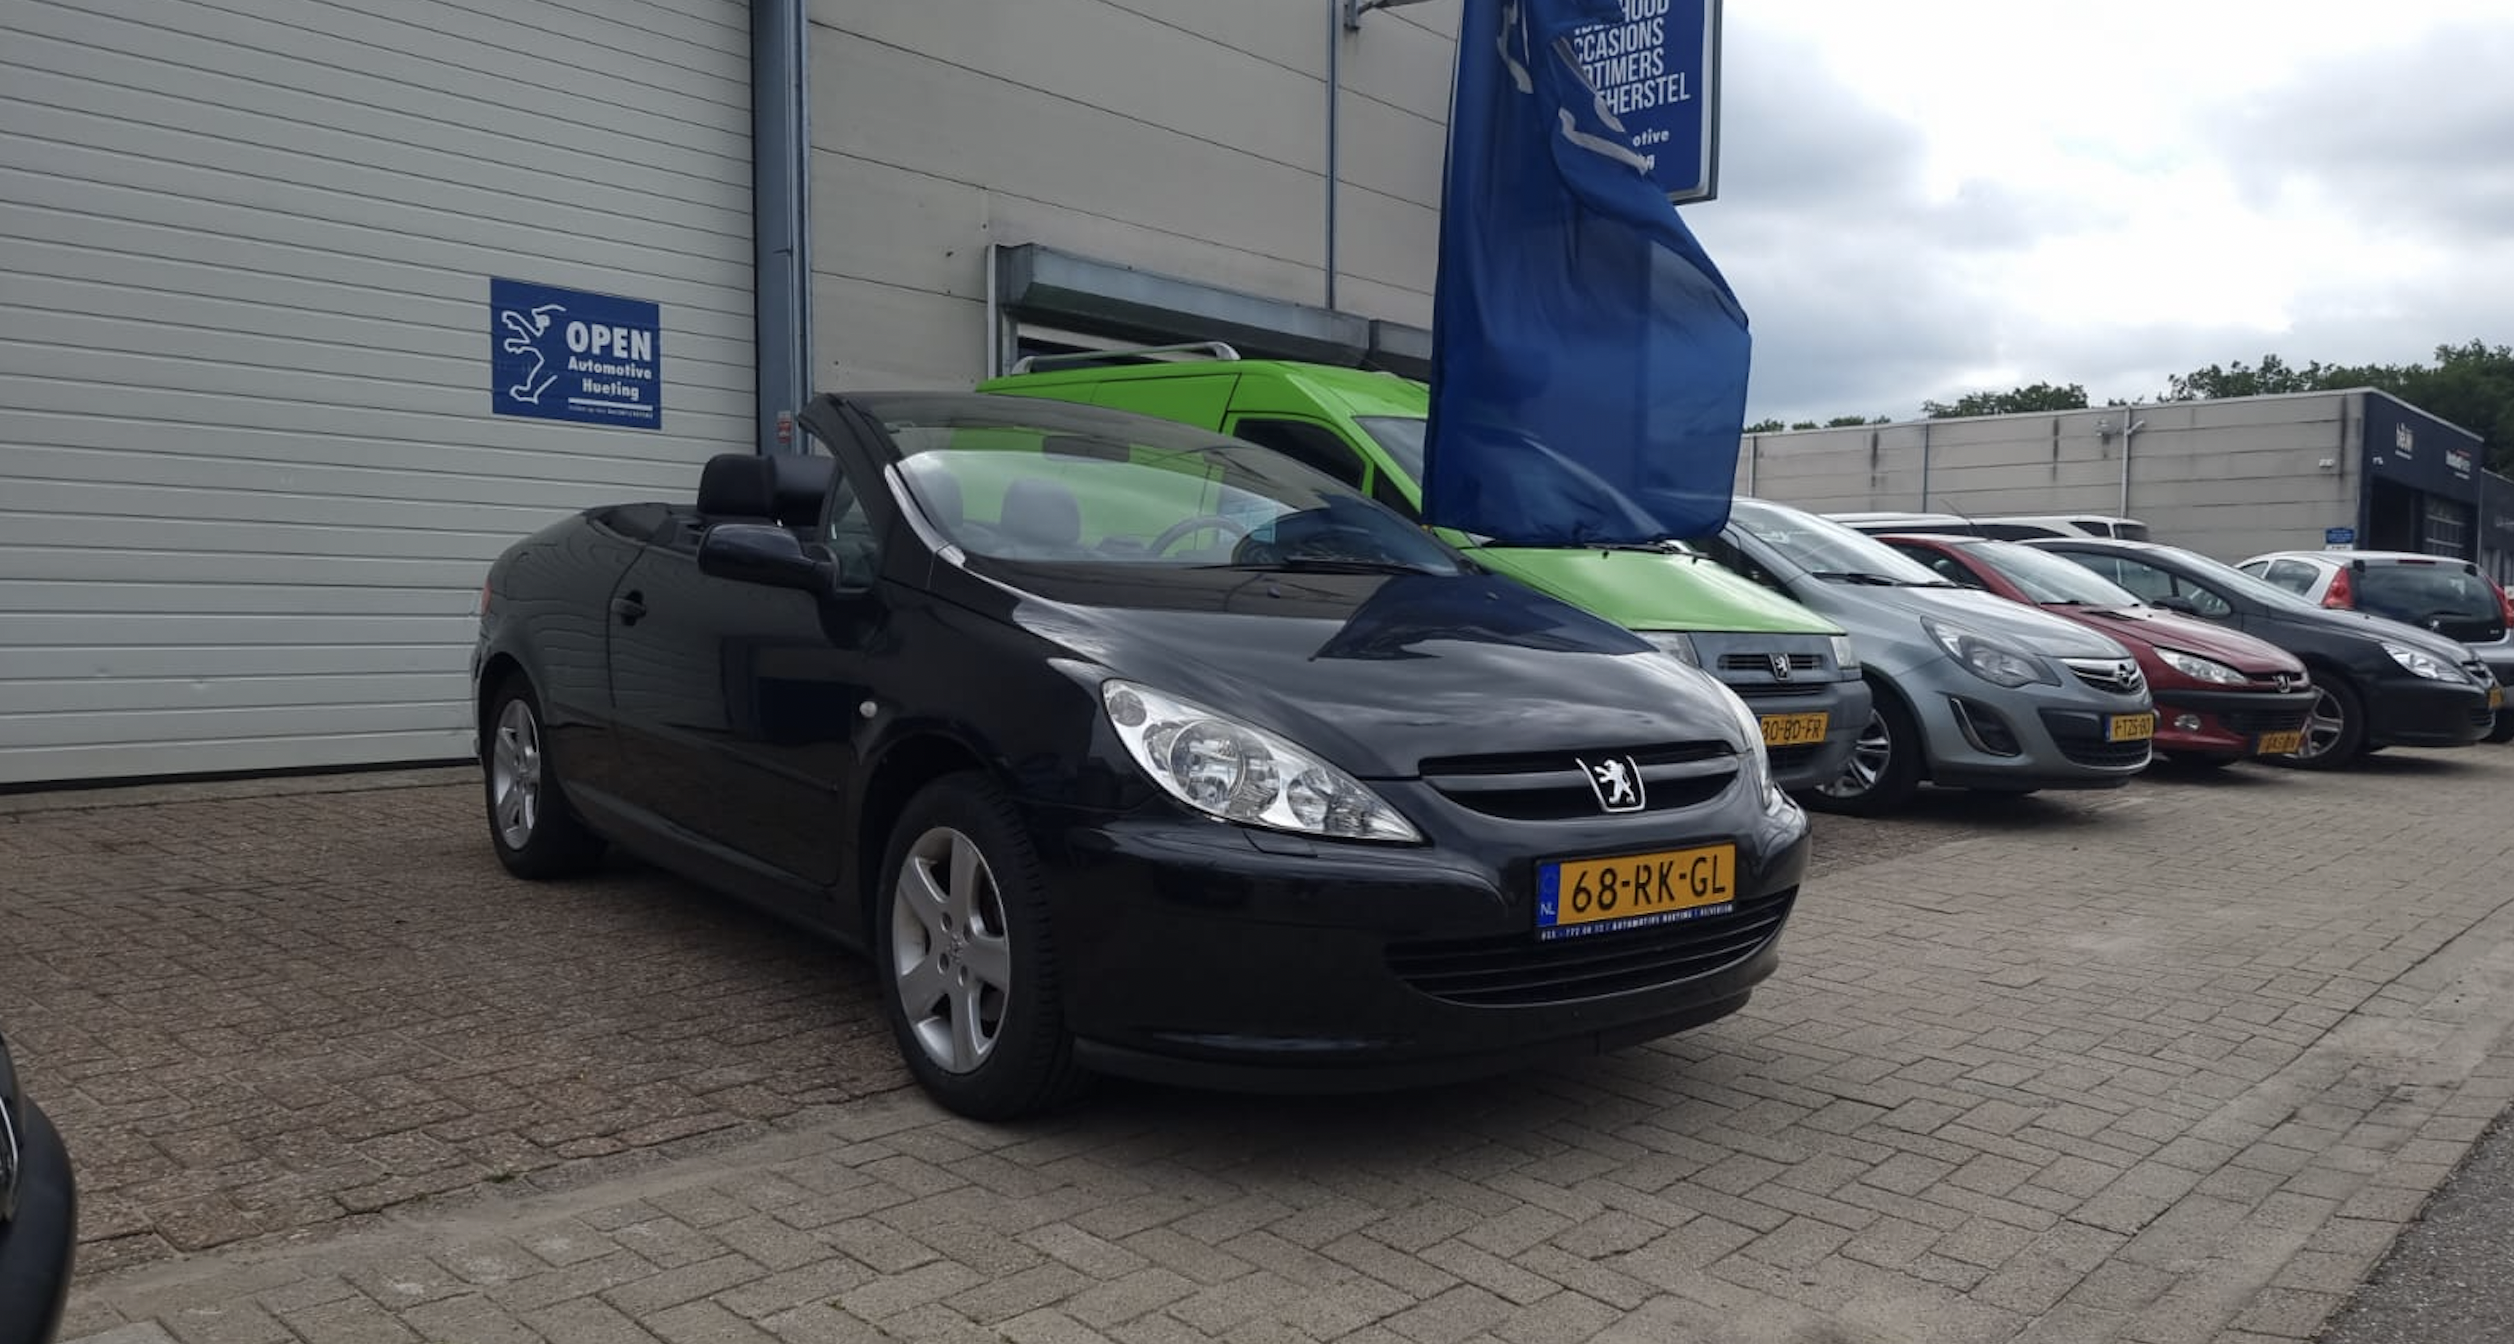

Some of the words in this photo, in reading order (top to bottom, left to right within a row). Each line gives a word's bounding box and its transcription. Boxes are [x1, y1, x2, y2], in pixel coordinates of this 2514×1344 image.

[1574, 17, 1665, 62] CCASIONS
[1598, 72, 1691, 115] HERSTEL
[1632, 128, 1669, 146] otive
[566, 320, 651, 362] OPEN
[568, 356, 652, 379] Automotive
[582, 378, 639, 401] Hueting
[1572, 854, 1726, 913] 68-RK-GL
[1540, 902, 1556, 916] NL
